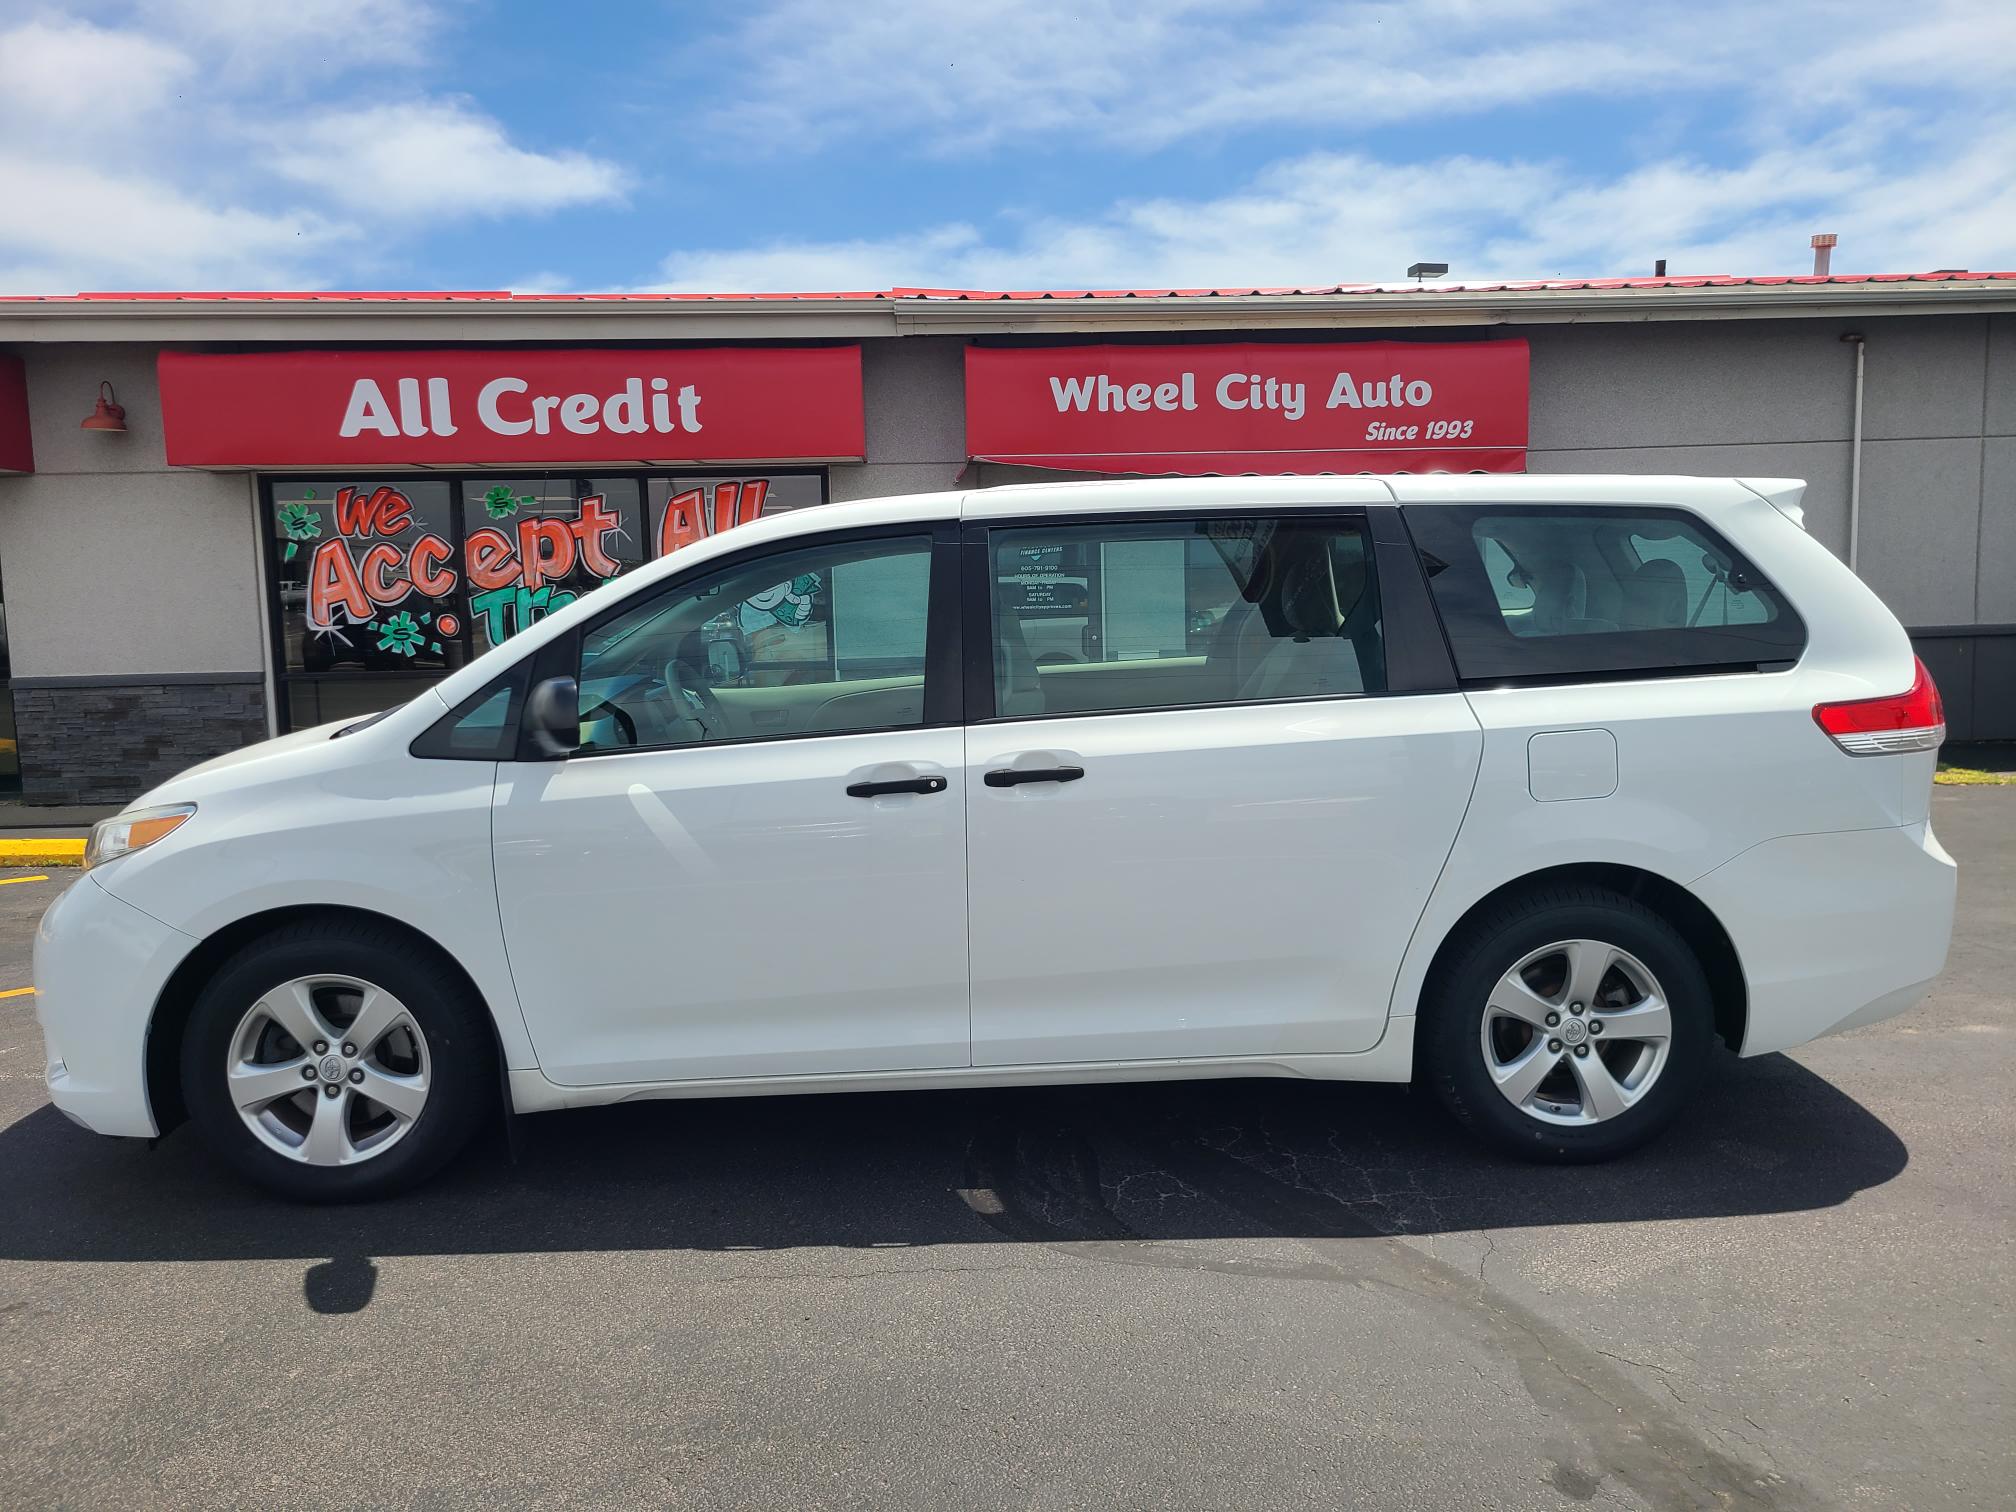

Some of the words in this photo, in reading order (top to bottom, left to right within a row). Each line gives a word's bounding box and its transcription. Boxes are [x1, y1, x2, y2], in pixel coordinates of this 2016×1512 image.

[339, 377, 458, 438] All
[477, 377, 703, 436] Credit
[1049, 372, 1198, 413] Wheel
[1216, 373, 1306, 420] City
[1325, 372, 1433, 409] Auto
[1365, 420, 1419, 441] Since
[1425, 420, 1475, 440] 1993
[307, 493, 624, 631] Accept
